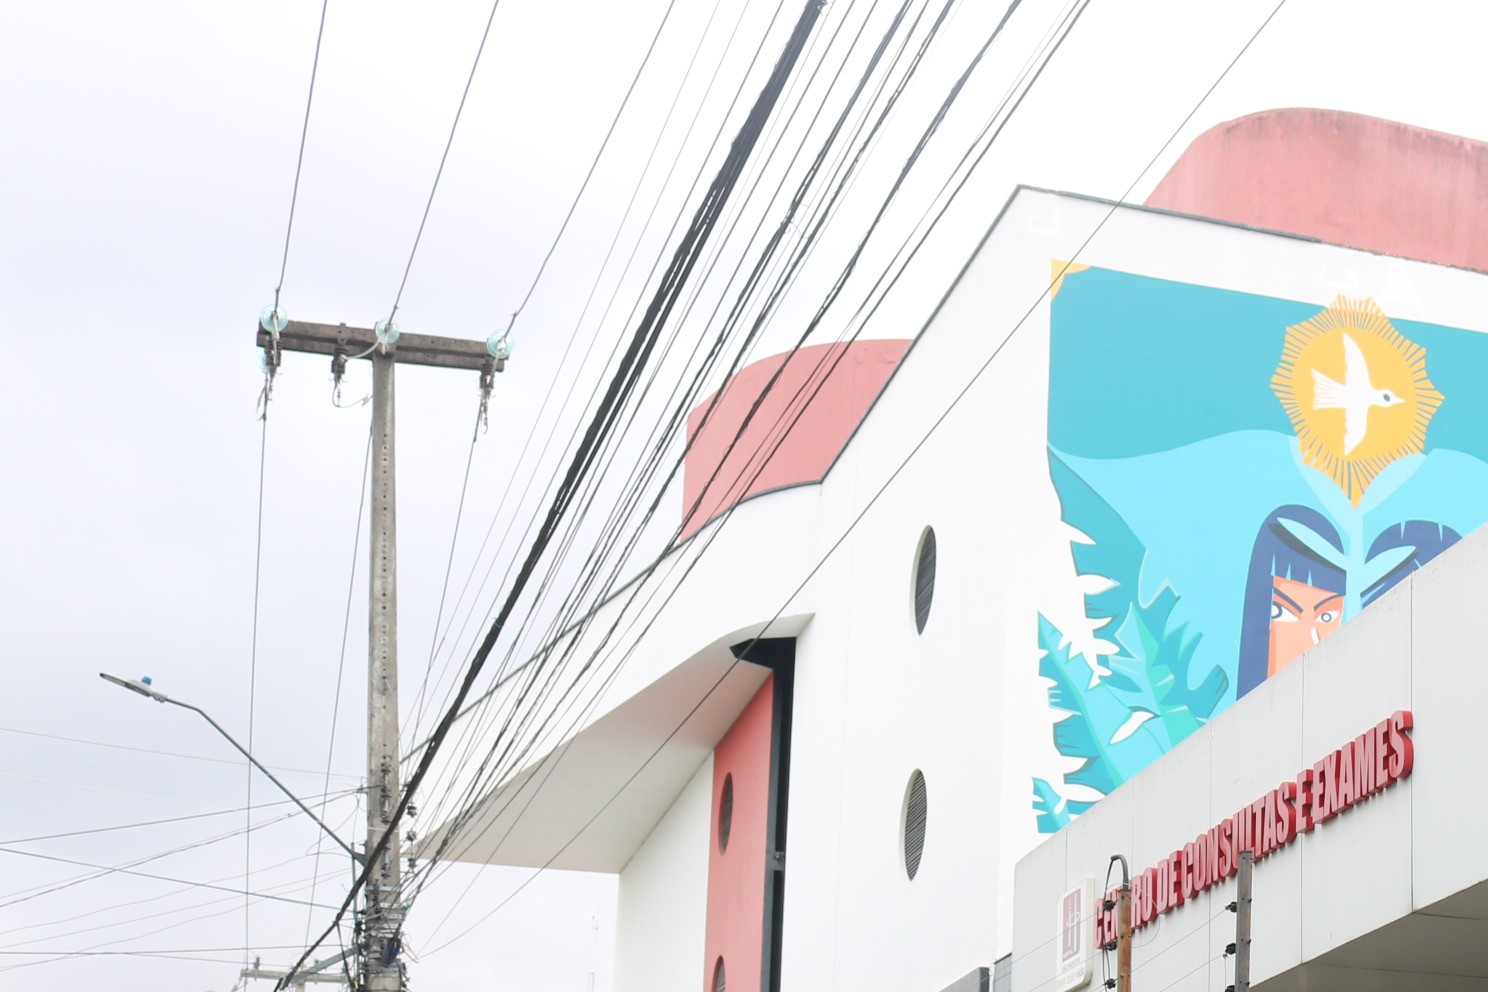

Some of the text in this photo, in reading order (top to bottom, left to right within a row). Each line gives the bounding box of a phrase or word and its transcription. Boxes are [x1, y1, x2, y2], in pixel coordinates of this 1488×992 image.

[1093, 710, 1414, 949] CENRO DE CONSULTAS E EXAMES
